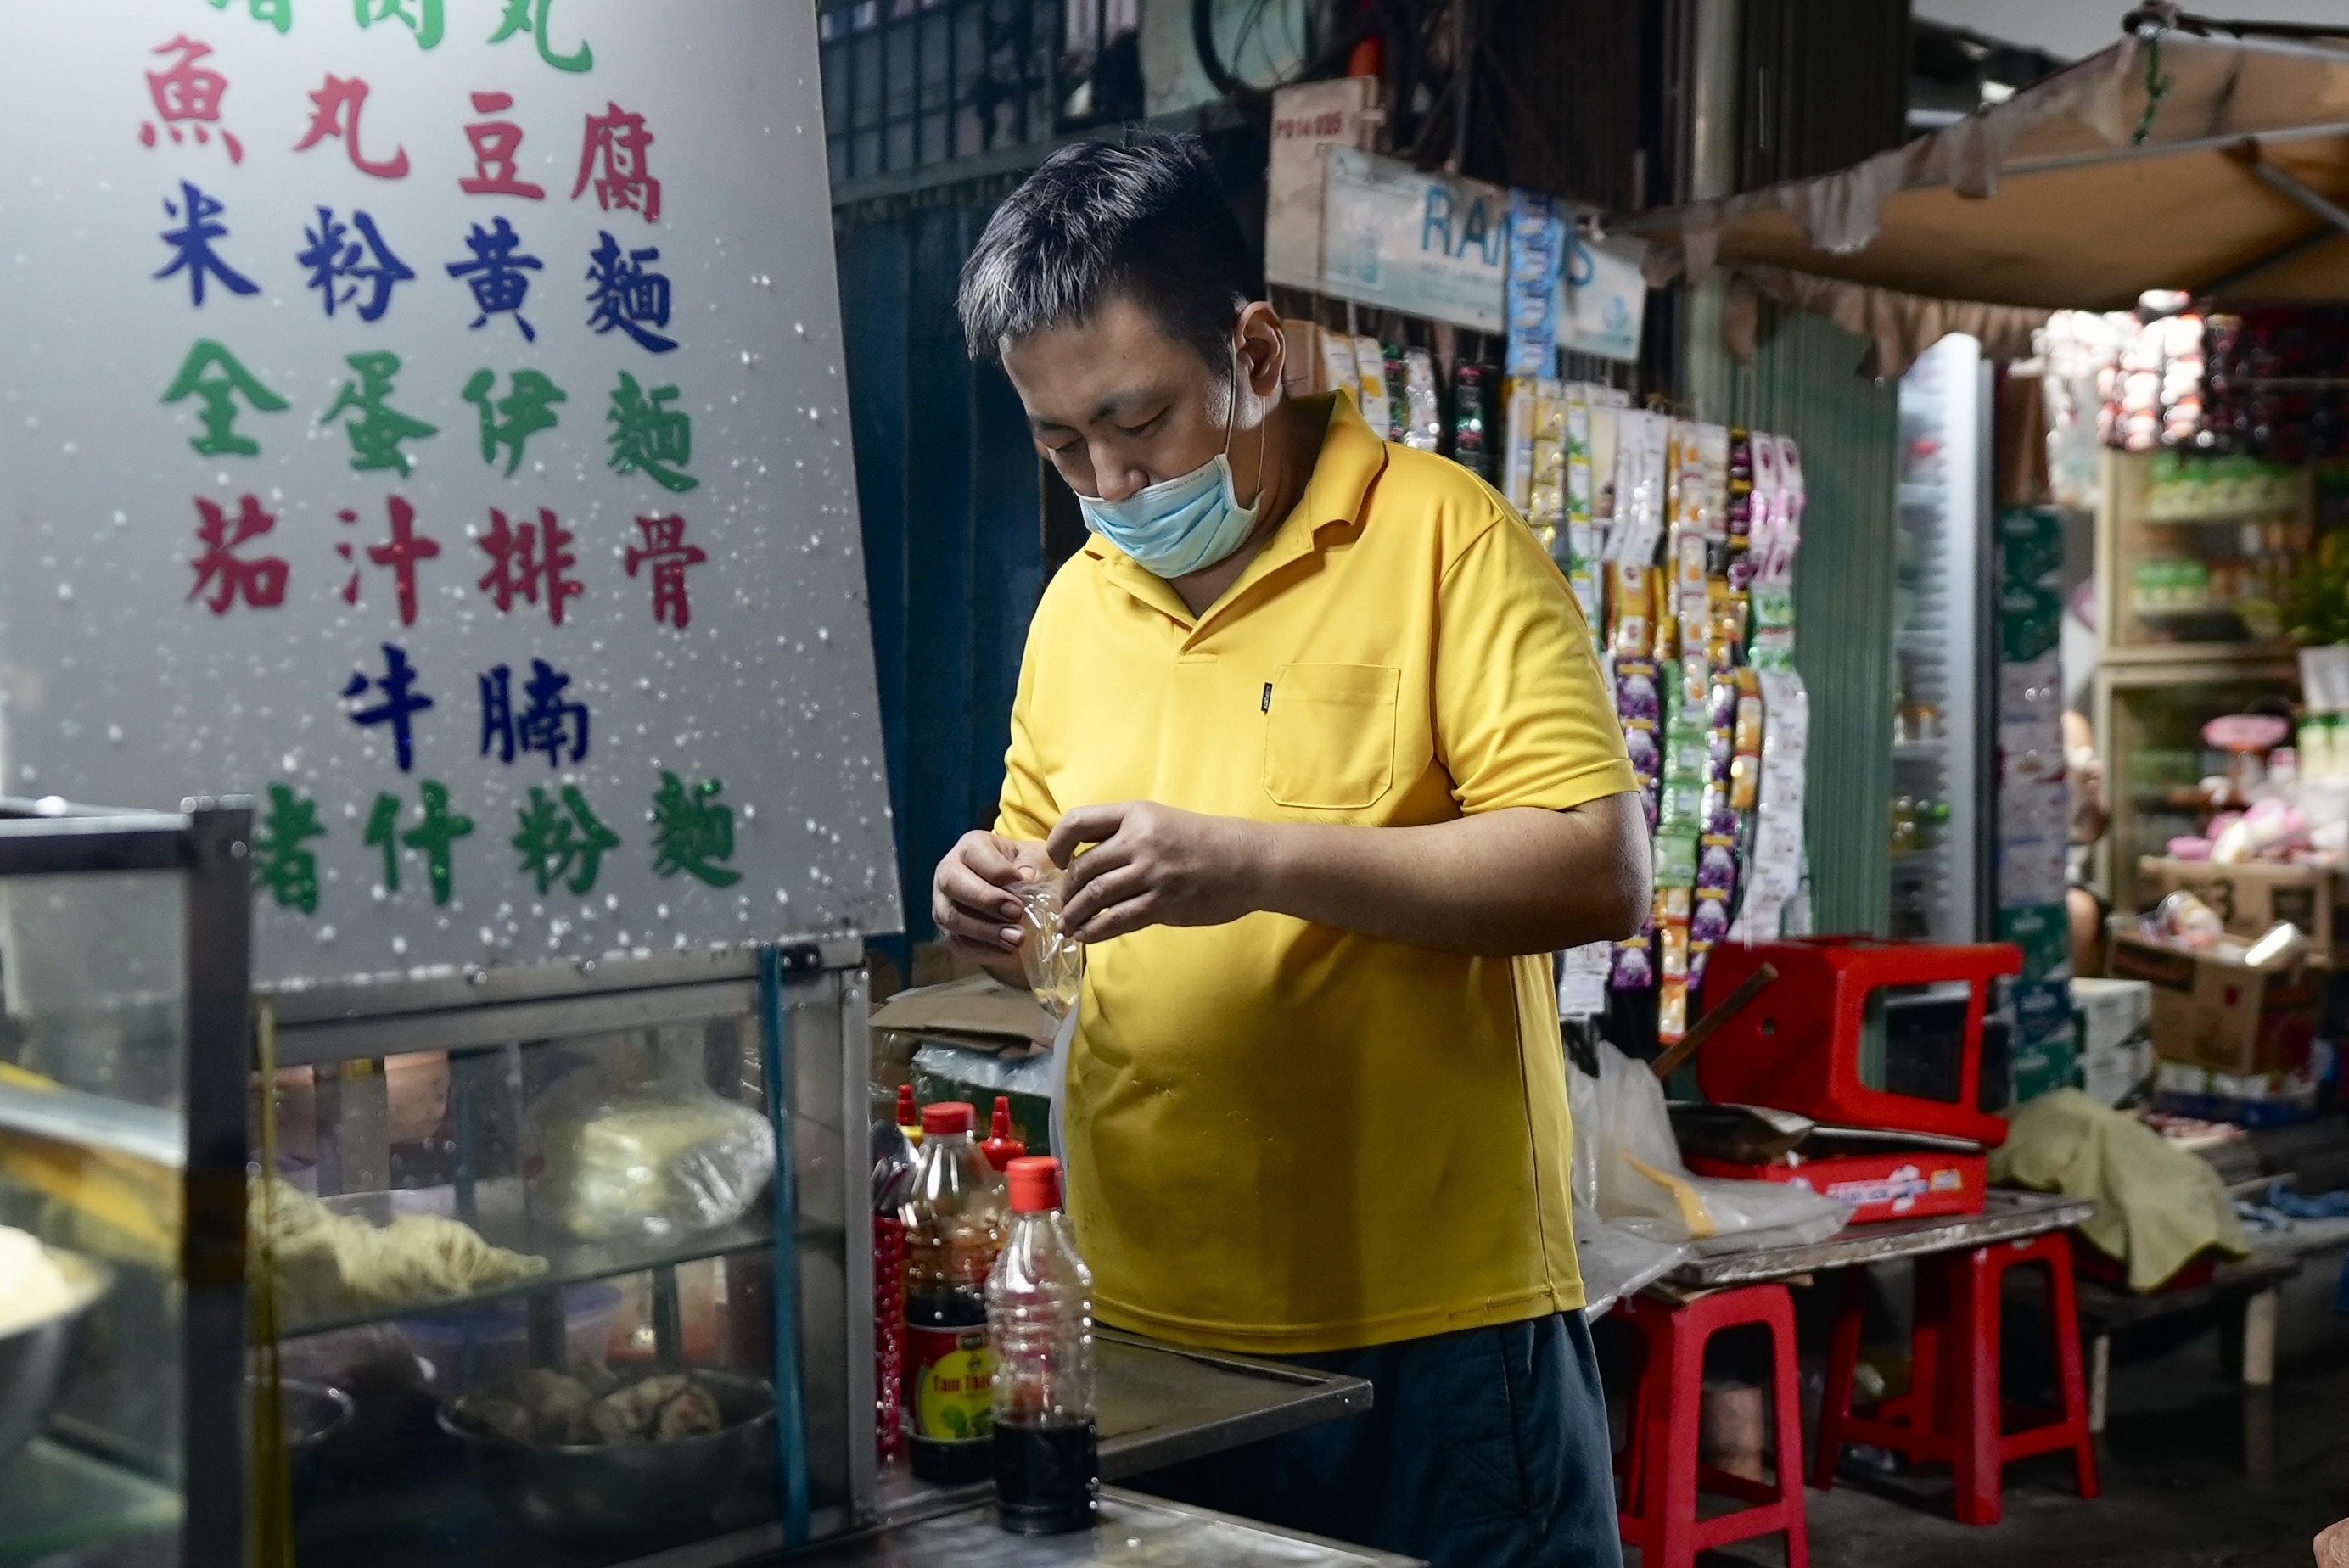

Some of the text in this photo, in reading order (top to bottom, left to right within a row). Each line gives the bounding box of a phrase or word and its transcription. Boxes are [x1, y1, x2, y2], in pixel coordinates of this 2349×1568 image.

[138, 32, 662, 223] 魚丸豆腐
[161, 338, 699, 493] 全蛋伊麵
[184, 493, 708, 628] 茄汁排骨
[341, 642, 591, 772] 牛腩
